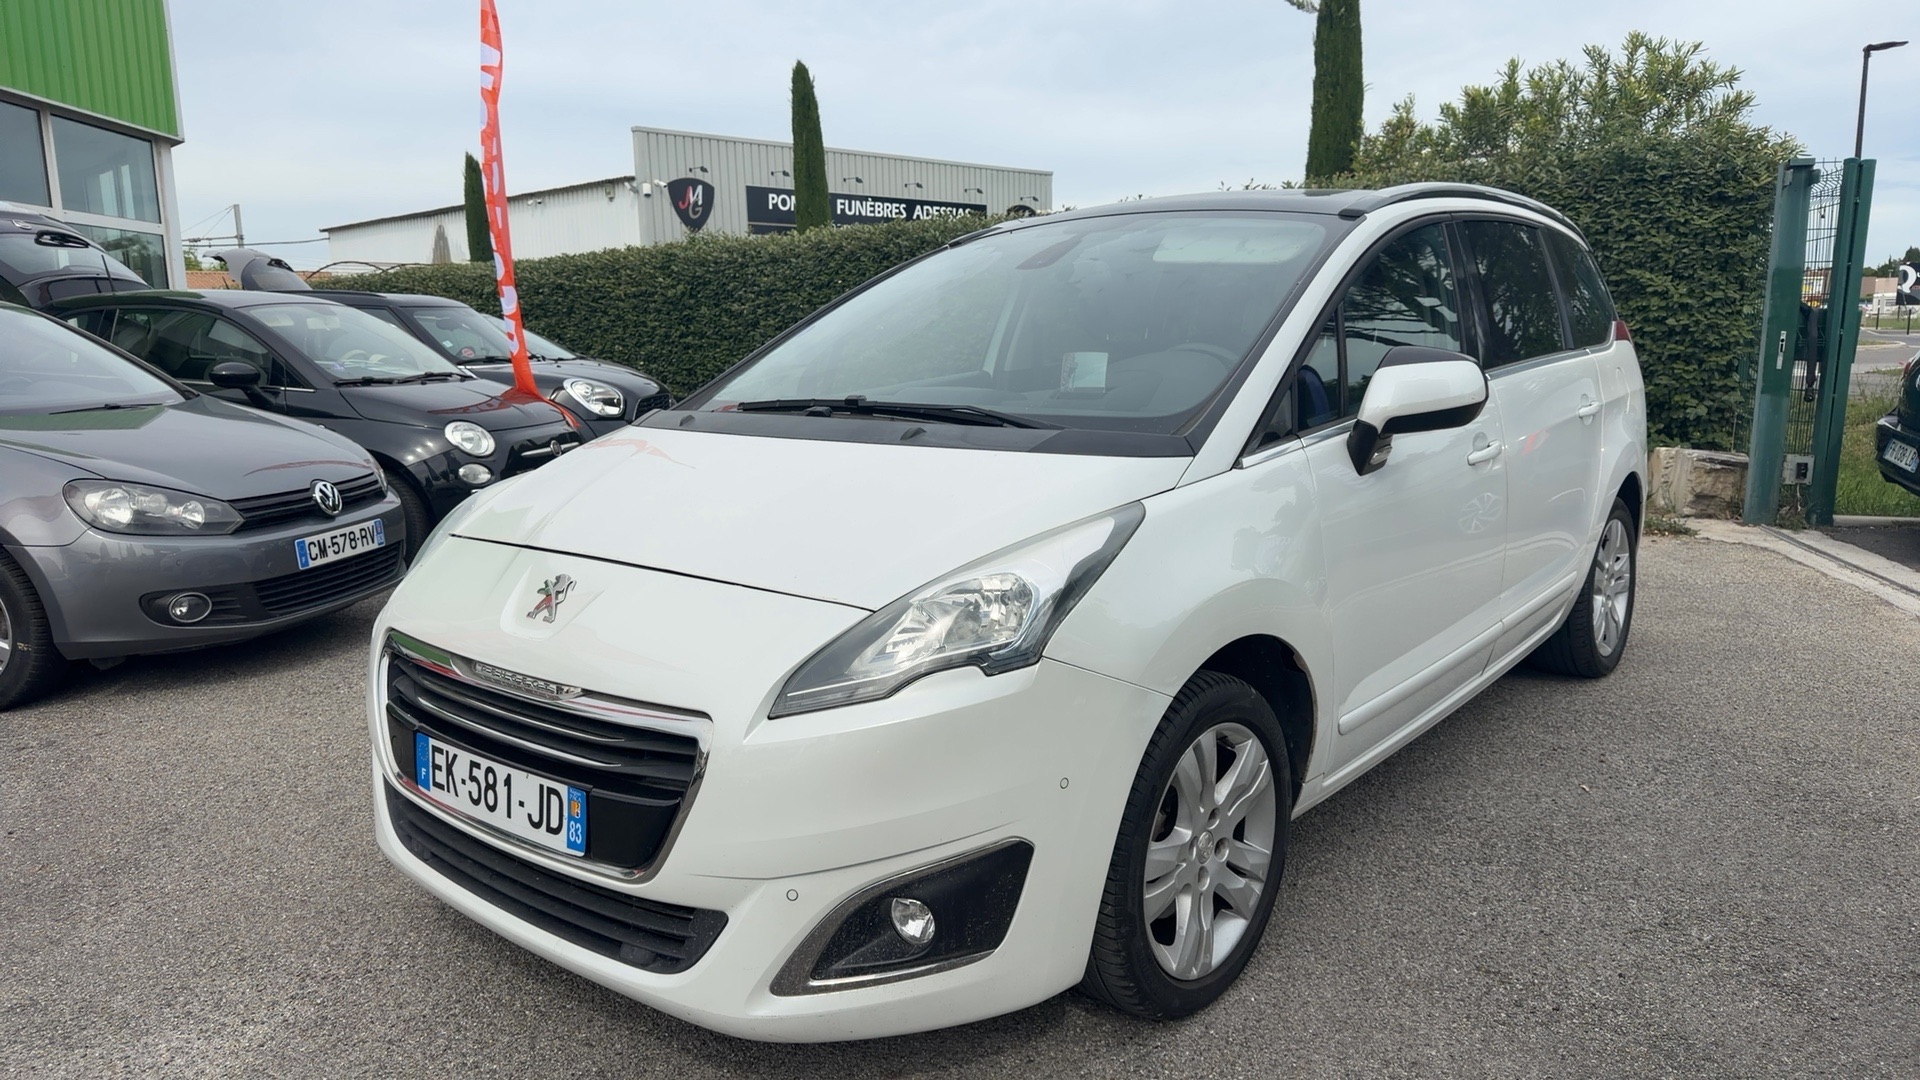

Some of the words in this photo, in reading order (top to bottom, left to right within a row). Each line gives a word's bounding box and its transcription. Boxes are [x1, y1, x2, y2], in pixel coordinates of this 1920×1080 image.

[836, 197, 907, 219] FUNÈBRES
[308, 524, 375, 562] CM-578-RV
[421, 767, 427, 780] F
[431, 744, 564, 836] EK-581-JD
[569, 820, 582, 845] 83
